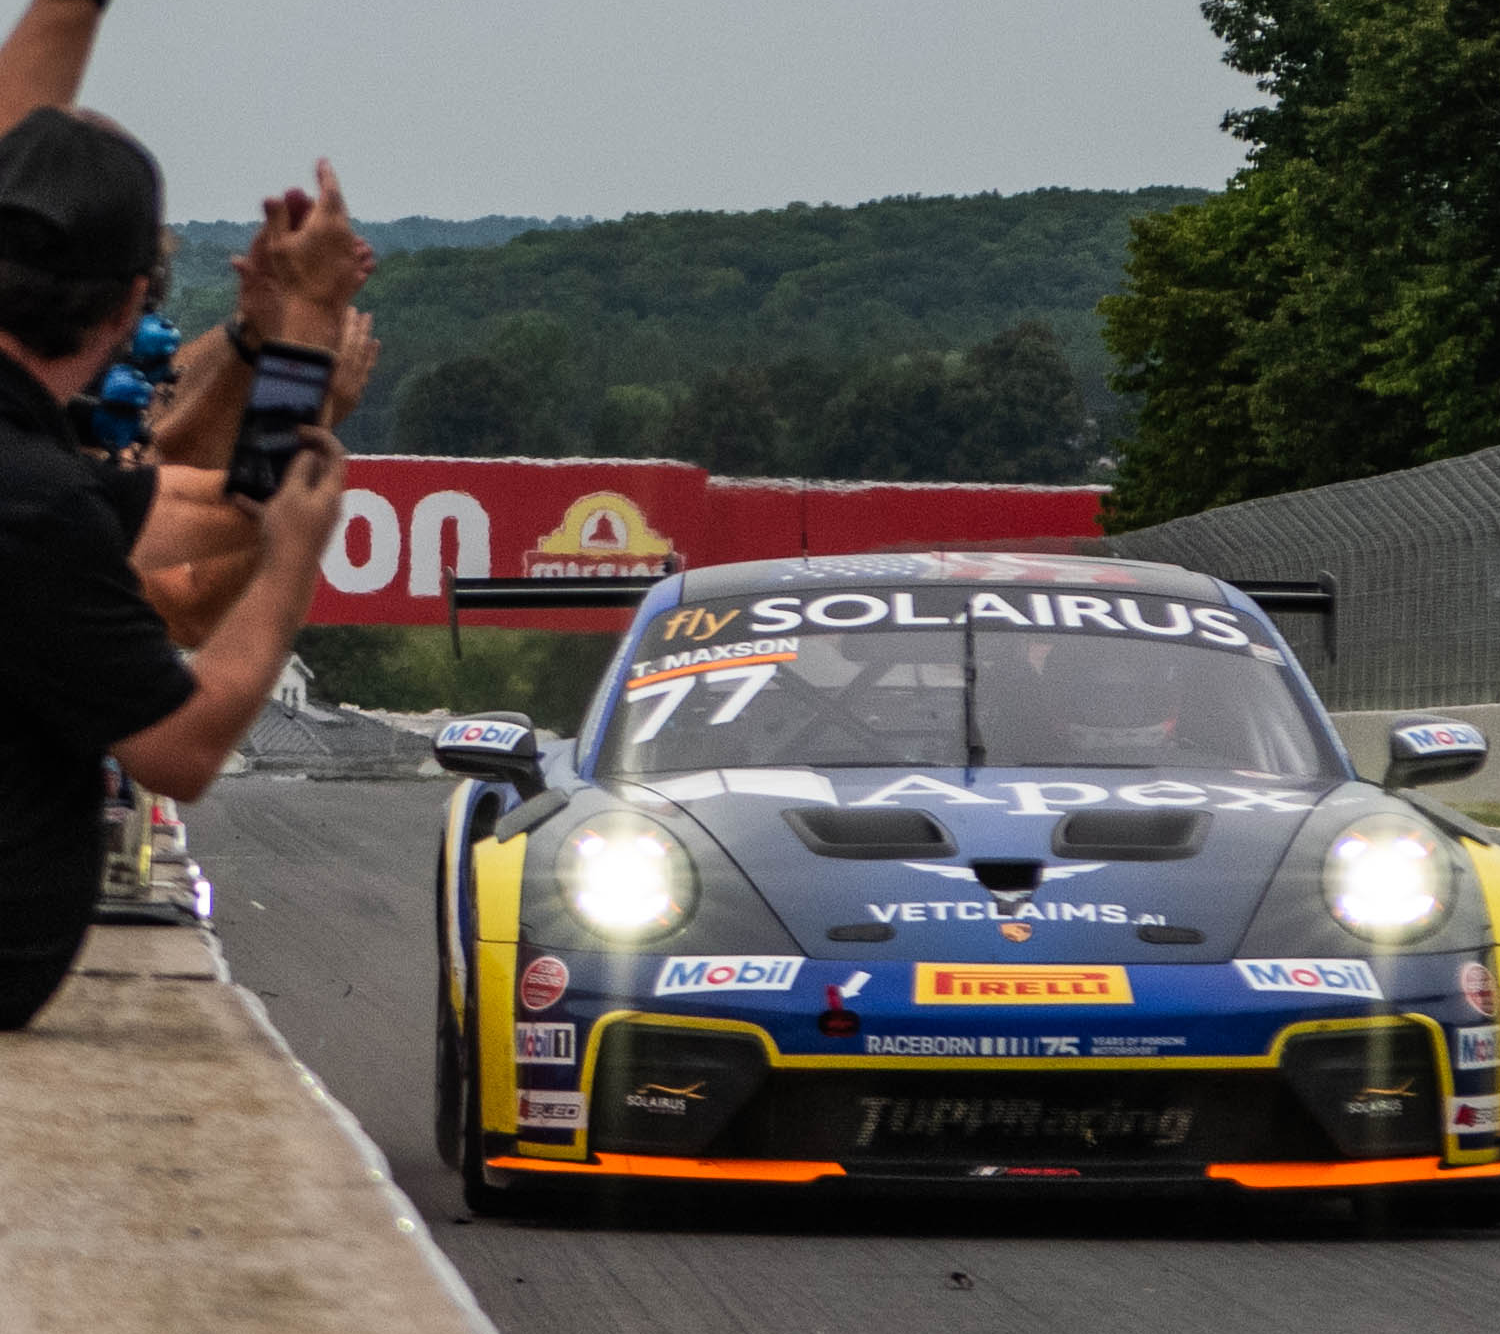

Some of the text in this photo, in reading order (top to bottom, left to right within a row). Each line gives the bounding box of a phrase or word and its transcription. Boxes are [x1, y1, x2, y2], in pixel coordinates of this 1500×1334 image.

[664, 607, 741, 641] fly
[751, 593, 1250, 648] SOLAIRUS
[632, 637, 799, 677] T. MAXSON
[627, 663, 778, 744] 77
[442, 723, 520, 745] Mobil
[664, 960, 793, 988] Mobil
[934, 971, 1110, 996] PIRELLI
[1246, 963, 1373, 991] Mobil
[865, 1034, 977, 1056] RACEBORN
[1039, 1036, 1080, 1056] 75
